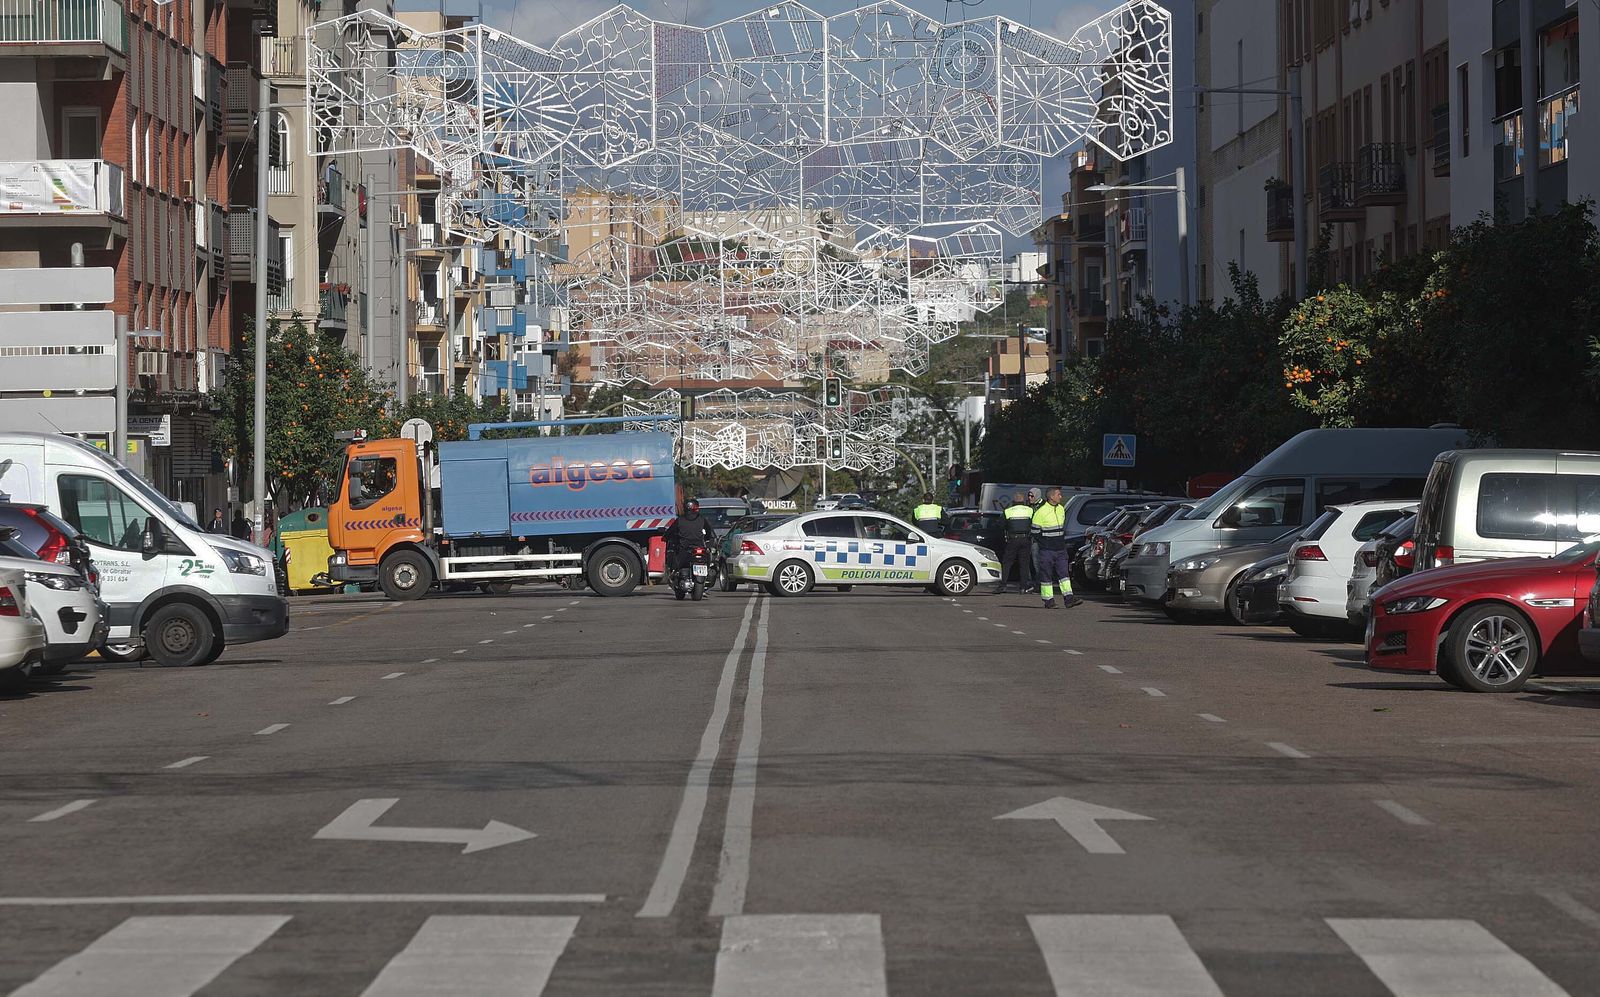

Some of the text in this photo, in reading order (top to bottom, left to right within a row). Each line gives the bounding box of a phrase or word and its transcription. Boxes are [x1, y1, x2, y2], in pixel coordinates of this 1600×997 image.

[530, 456, 653, 491] algesa
[841, 570, 914, 580] POLICIA LOCAL
